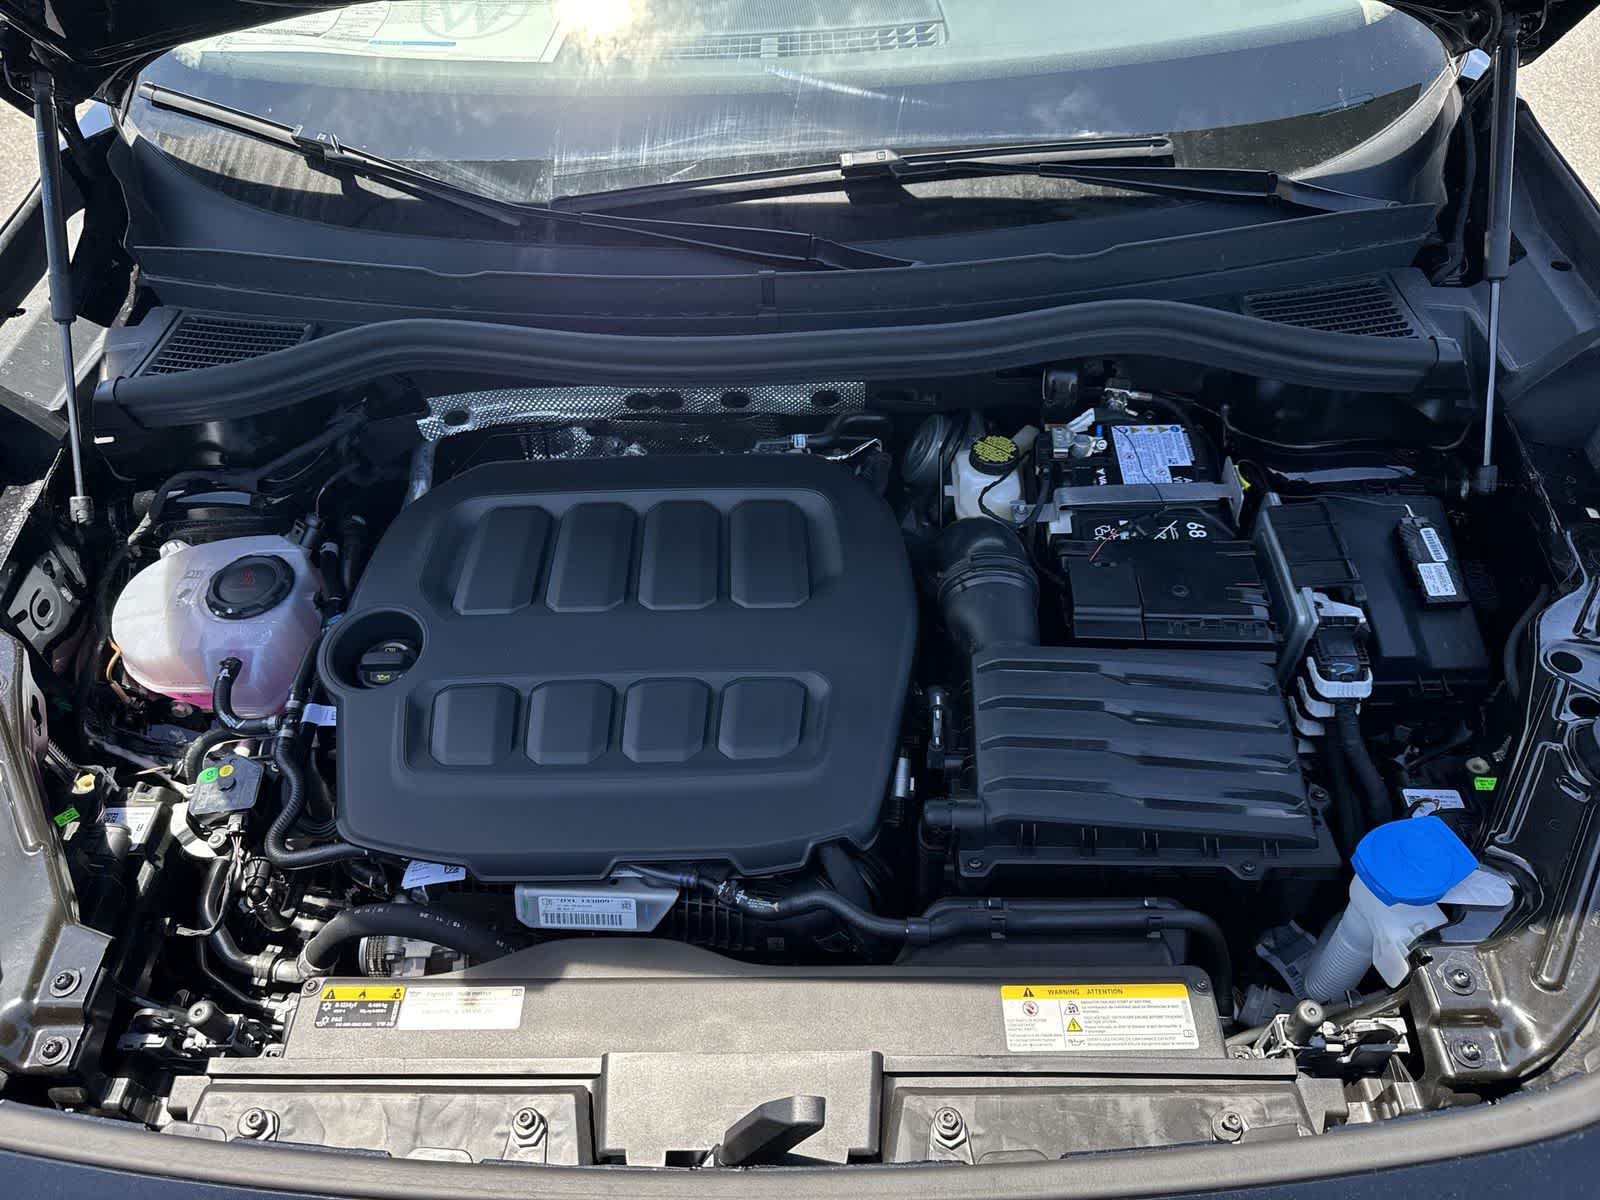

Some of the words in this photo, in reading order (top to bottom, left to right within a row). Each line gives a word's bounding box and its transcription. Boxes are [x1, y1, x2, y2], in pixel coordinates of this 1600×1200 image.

[1186, 521, 1207, 538] 68
[1047, 988, 1080, 996] WARNING
[1086, 988, 1123, 996] ATTENTION
